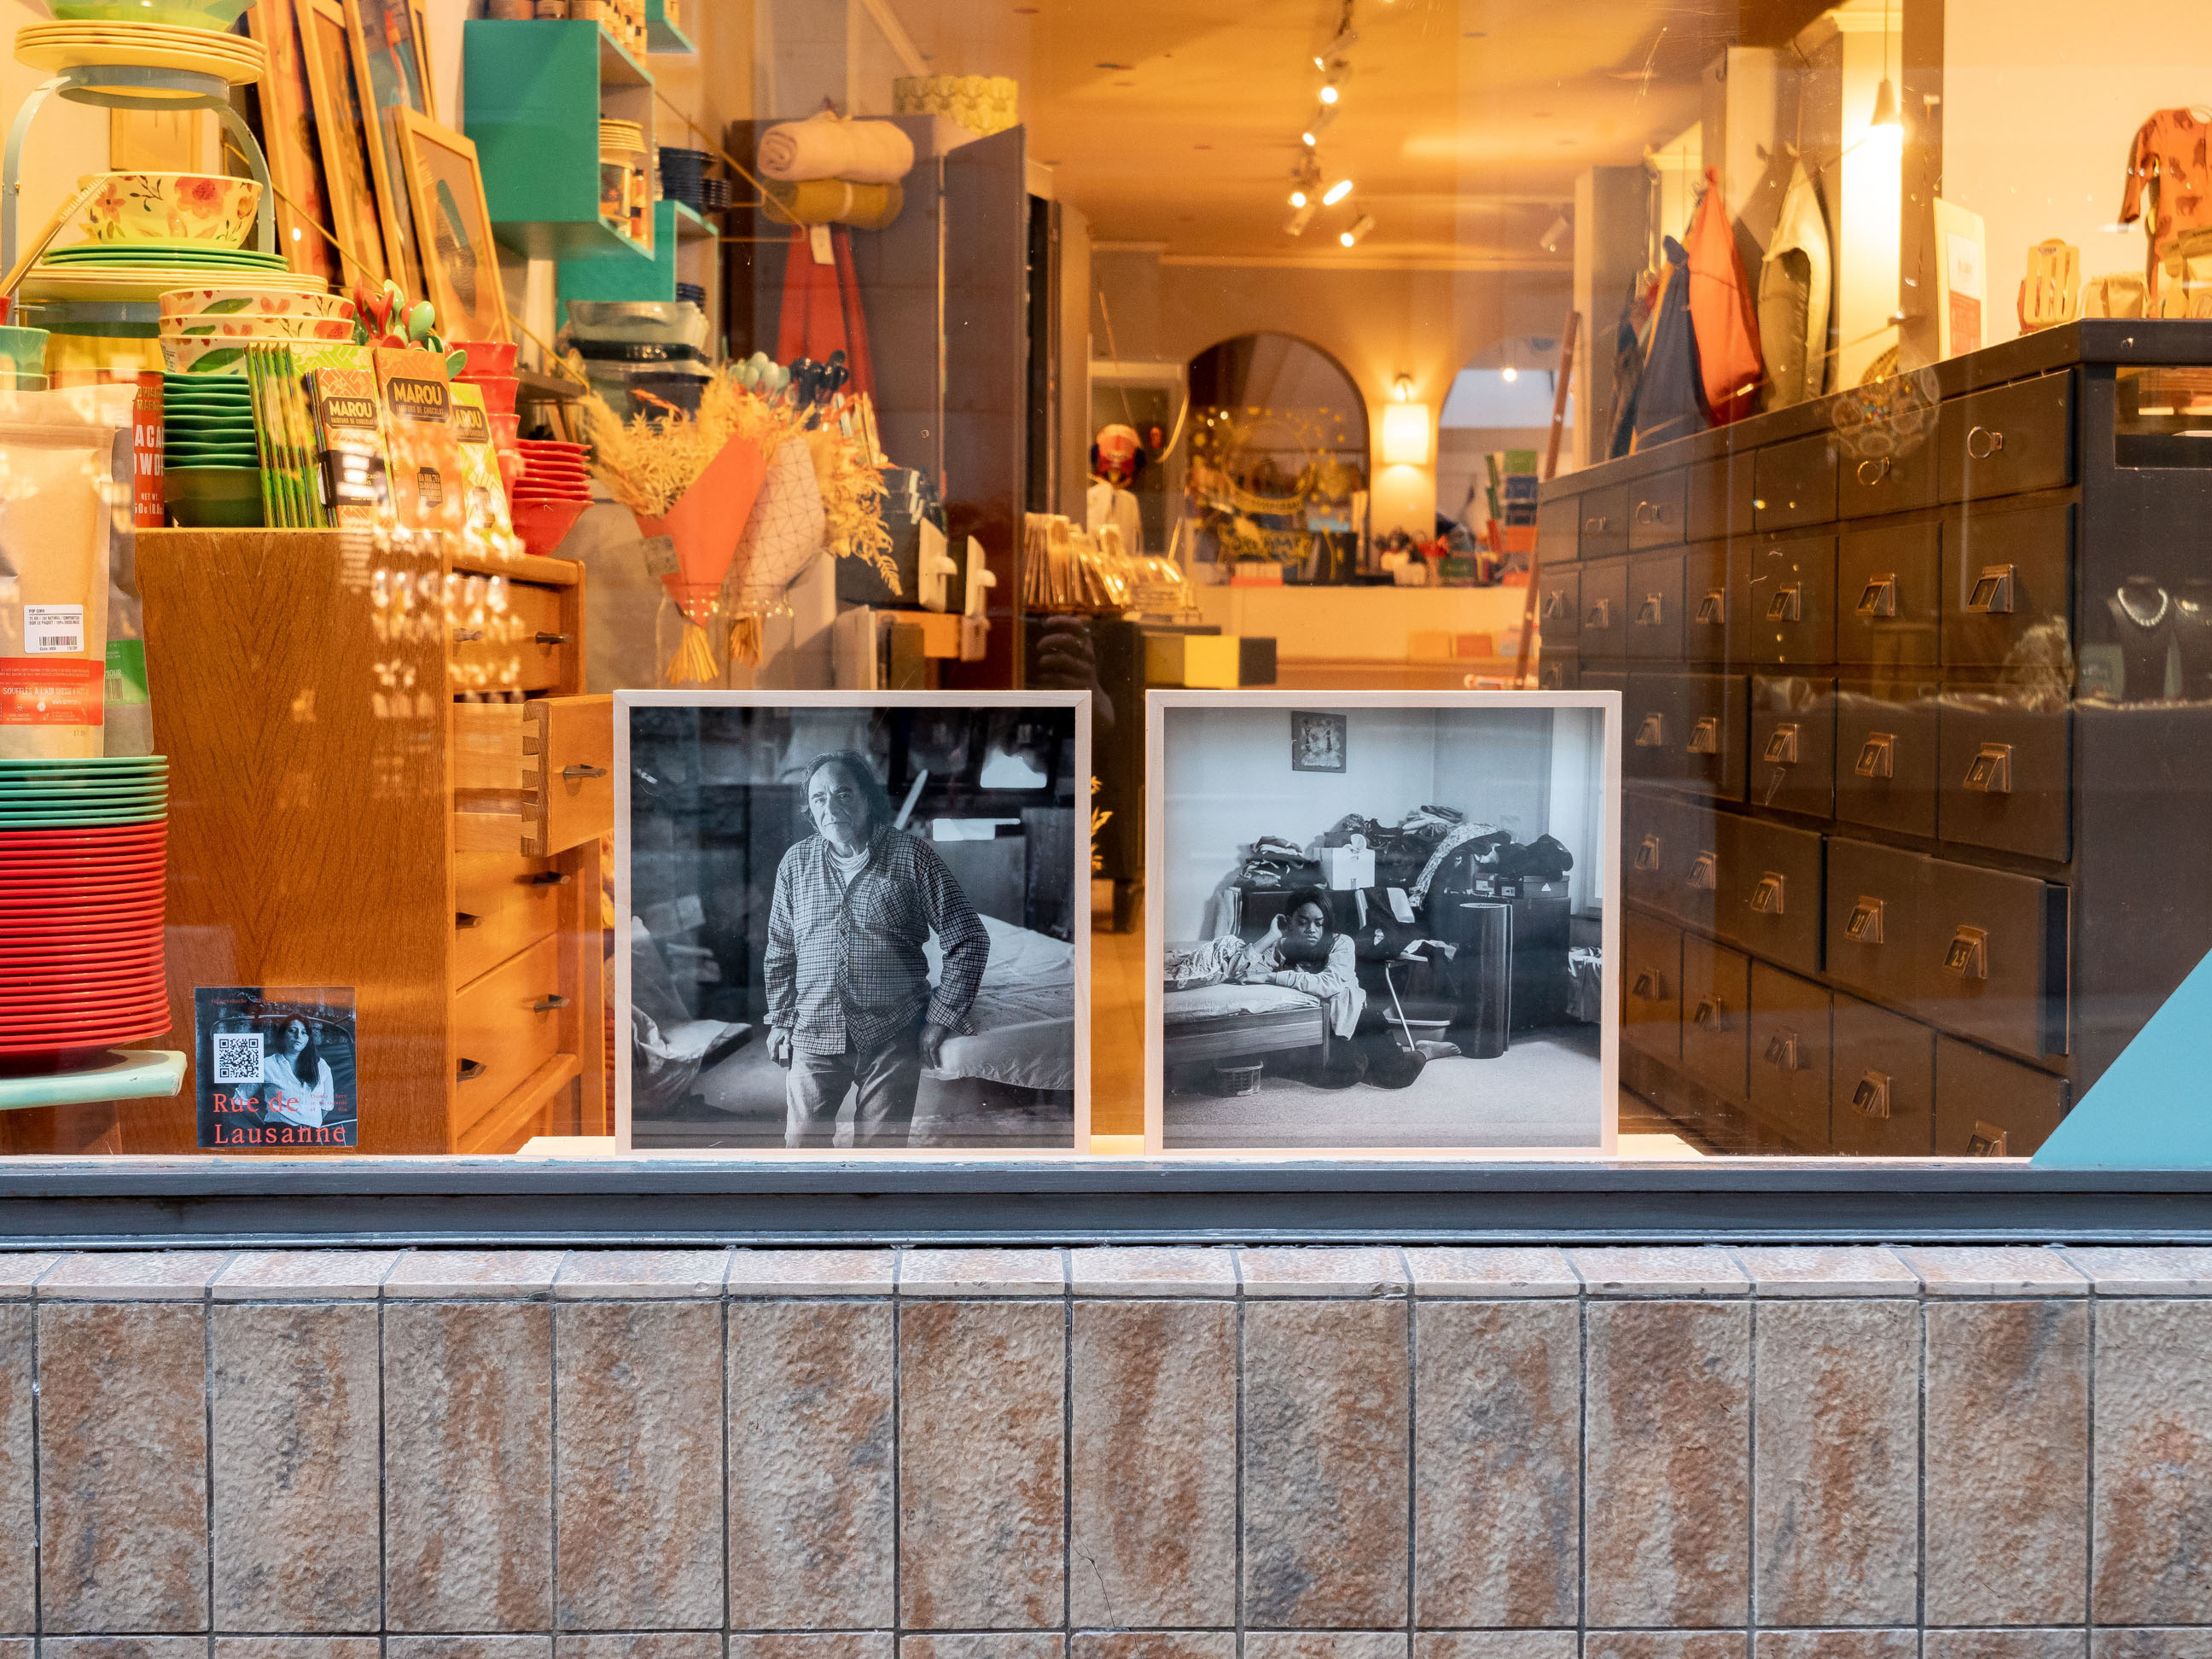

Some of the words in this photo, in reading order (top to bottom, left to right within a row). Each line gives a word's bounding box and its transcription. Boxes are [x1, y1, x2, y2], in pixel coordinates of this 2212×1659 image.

[393, 381, 443, 406] MAROU
[329, 400, 373, 418] MAROU
[454, 409, 483, 428] AROU
[140, 492, 150, 501] NET
[212, 1092, 260, 1113] Rue
[269, 1090, 300, 1113] de
[214, 1123, 346, 1144] Lausanne
